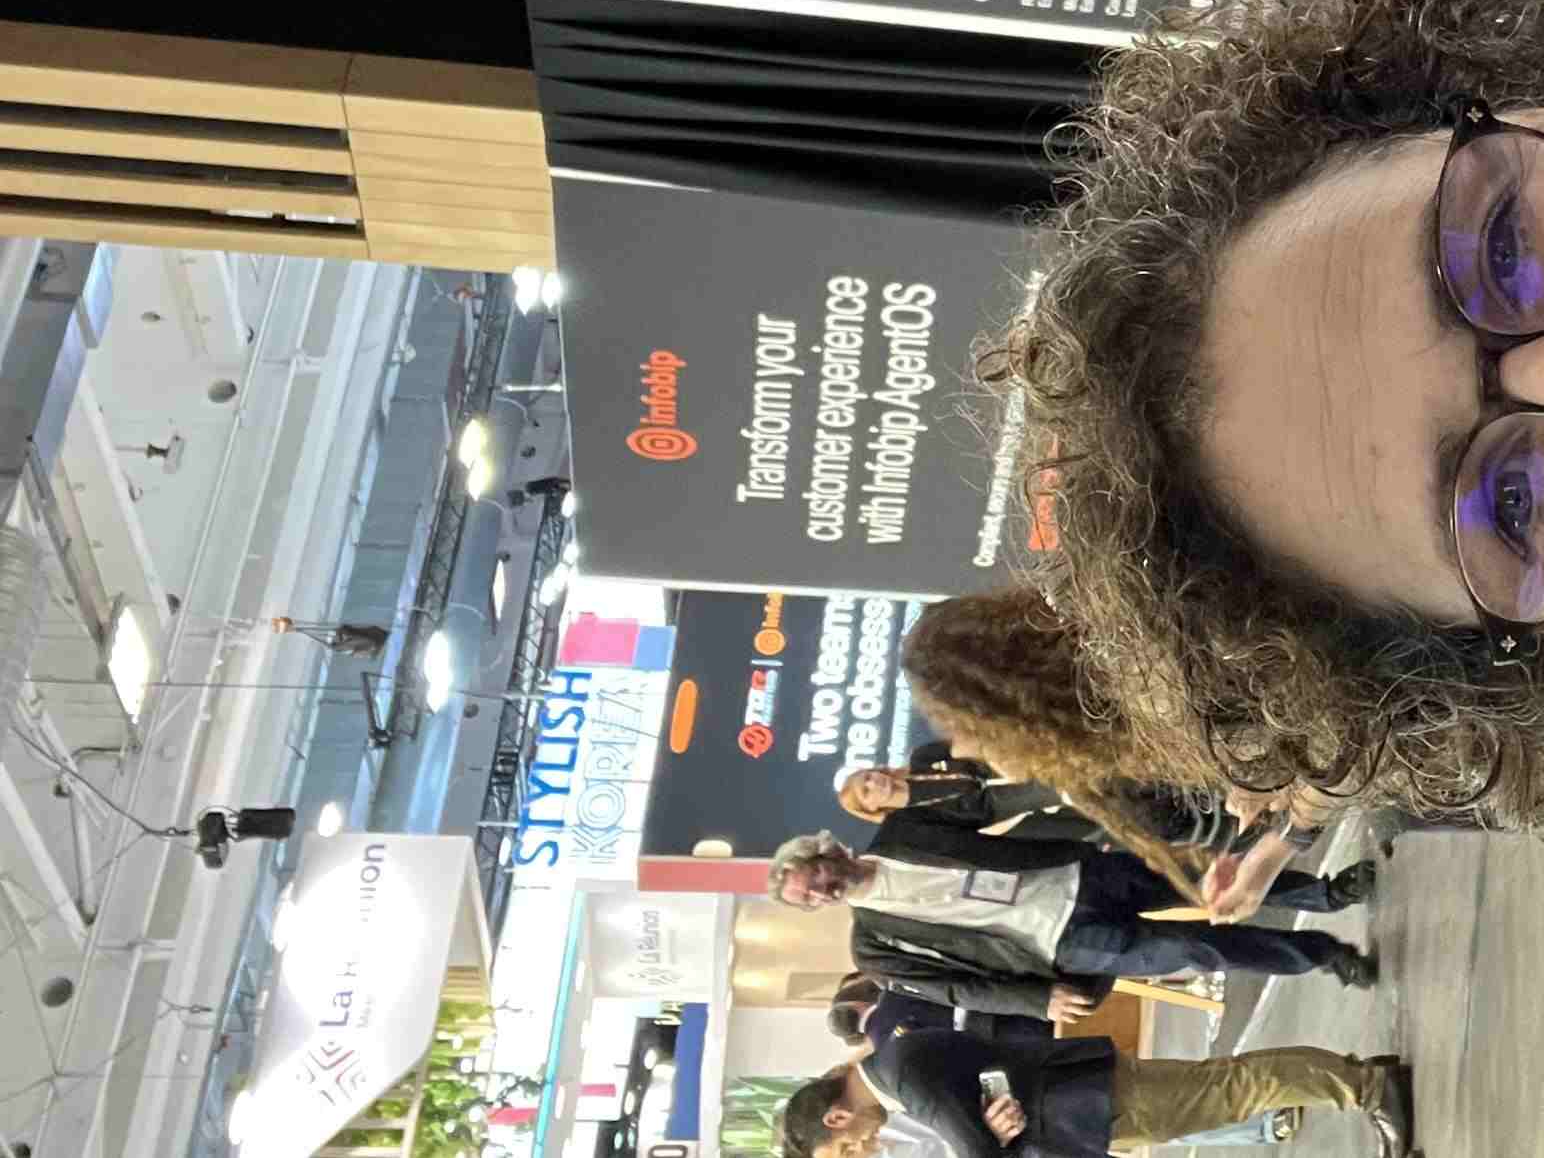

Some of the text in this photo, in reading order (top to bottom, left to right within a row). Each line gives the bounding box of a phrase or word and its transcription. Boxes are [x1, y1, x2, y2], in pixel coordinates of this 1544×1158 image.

[877, 282, 937, 409] AgentOS
[640, 350, 687, 426] infobip
[737, 314, 805, 502] Transform your
[804, 276, 869, 541] customer experience
[862, 409, 928, 493] Infobip
[858, 497, 907, 544] with
[797, 689, 843, 762] Two
[511, 669, 593, 867] STYLISH
[318, 990, 353, 1028] La
